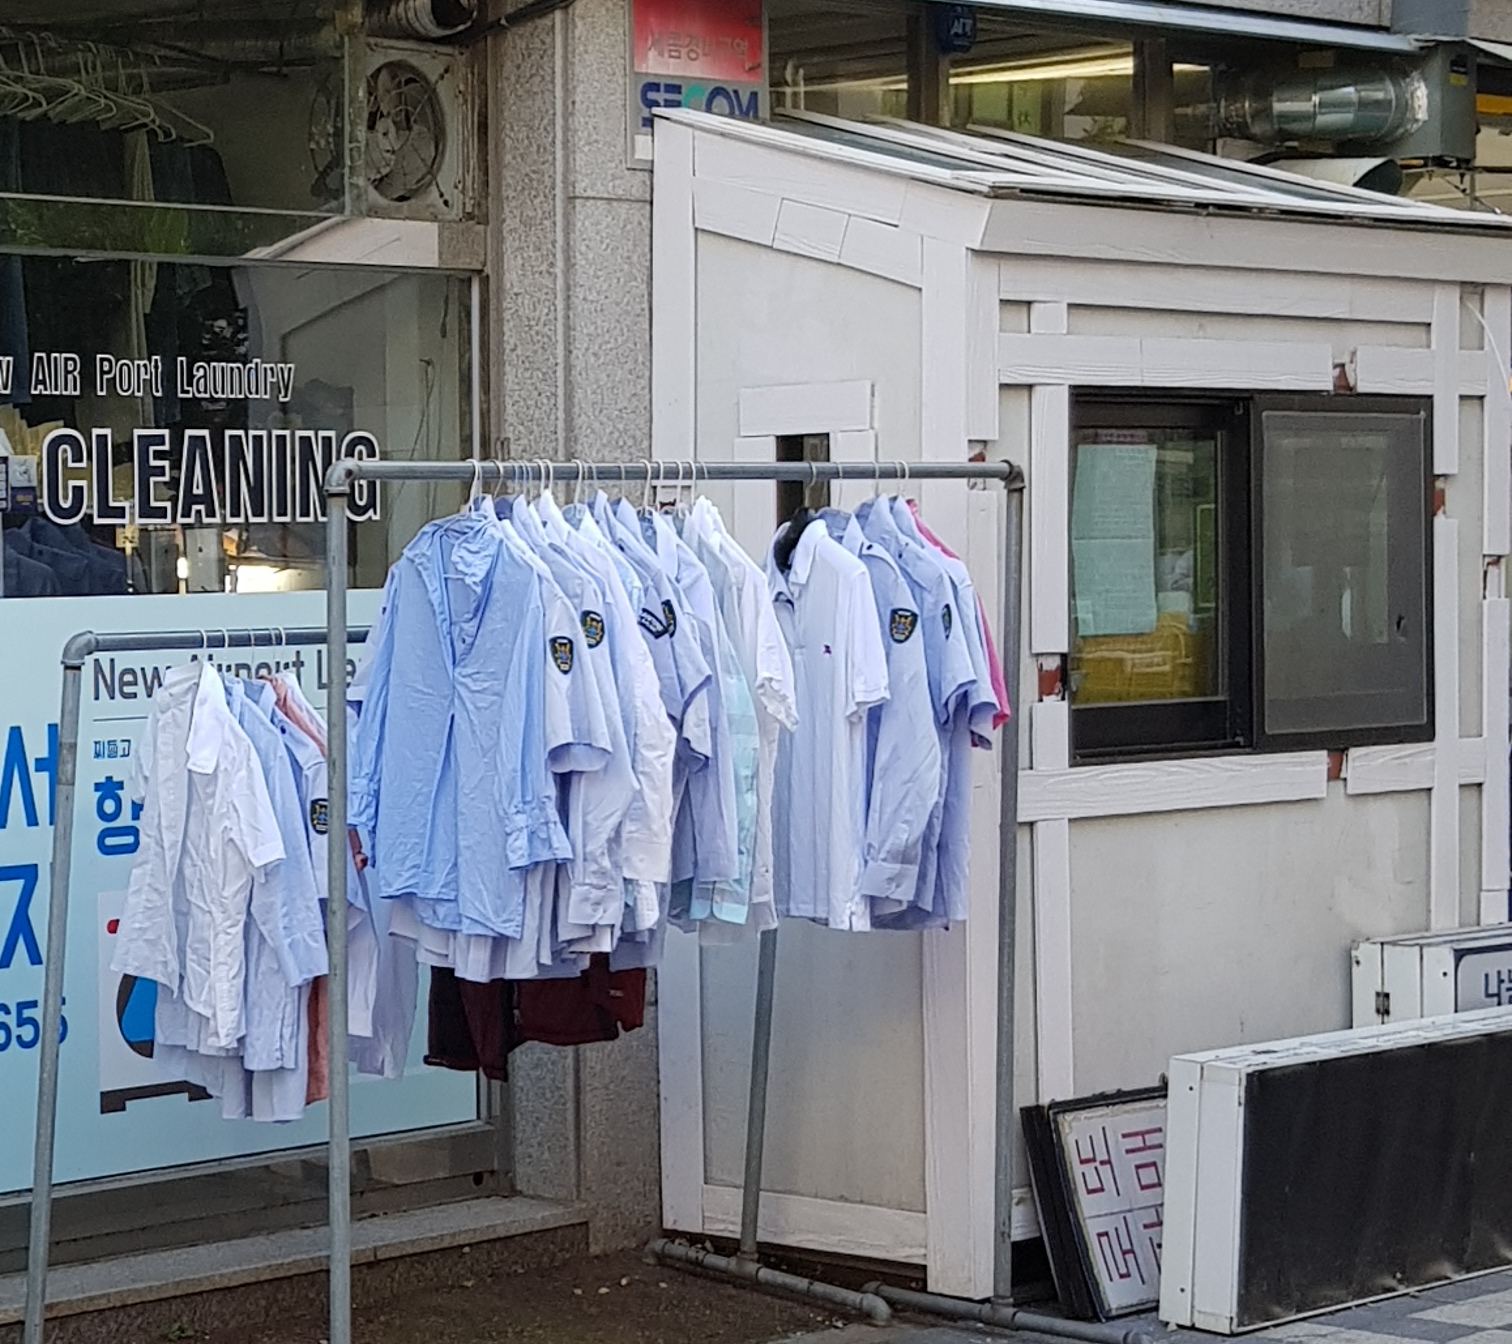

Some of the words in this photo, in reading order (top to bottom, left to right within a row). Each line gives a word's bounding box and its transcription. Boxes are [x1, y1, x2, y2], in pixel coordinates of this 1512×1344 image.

[31, 353, 80, 396] AIR
[96, 354, 162, 398] Port
[177, 357, 295, 402] Laundry
[42, 426, 381, 527] CLEANING
